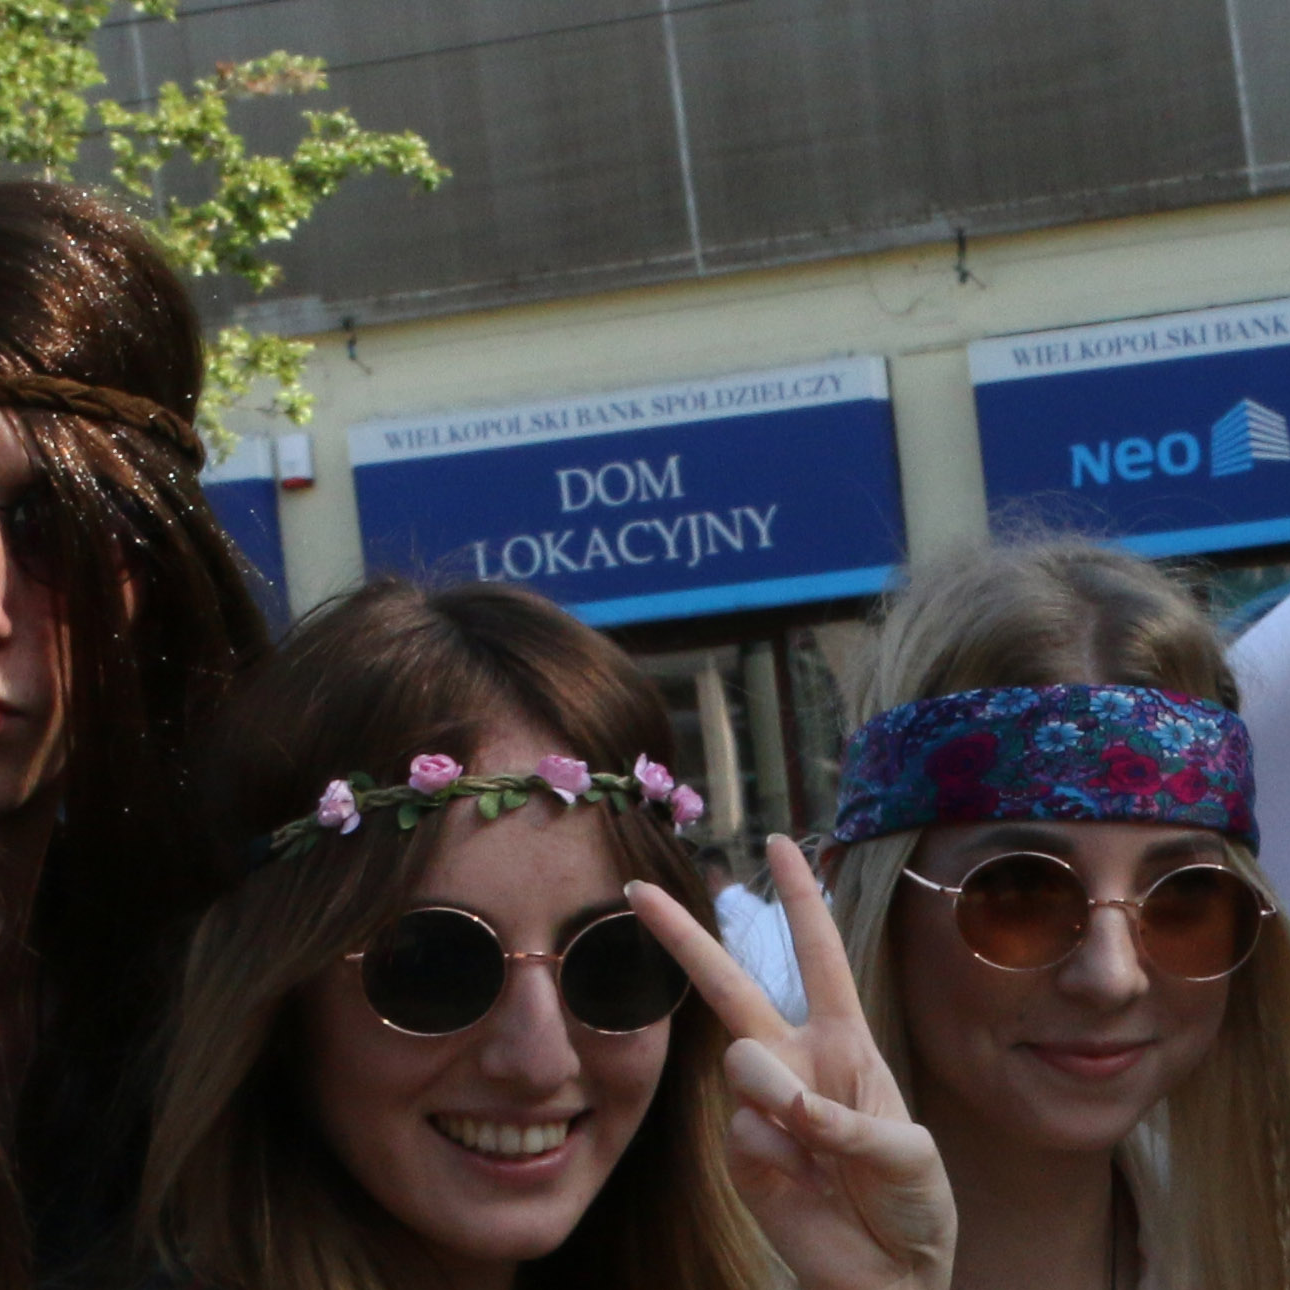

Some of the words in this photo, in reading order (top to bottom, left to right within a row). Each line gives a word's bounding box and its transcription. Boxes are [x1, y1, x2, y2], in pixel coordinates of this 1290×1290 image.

[1012, 325, 1210, 369] WIELKOPOLSKI
[1214, 314, 1289, 344] BANK
[384, 411, 570, 452] WIELKOPOLSKI
[576, 401, 645, 432] BANK
[651, 372, 846, 419] SPÓŁDZIELCZY
[556, 454, 685, 513] DOM
[473, 504, 779, 582] LOKACYJNY
